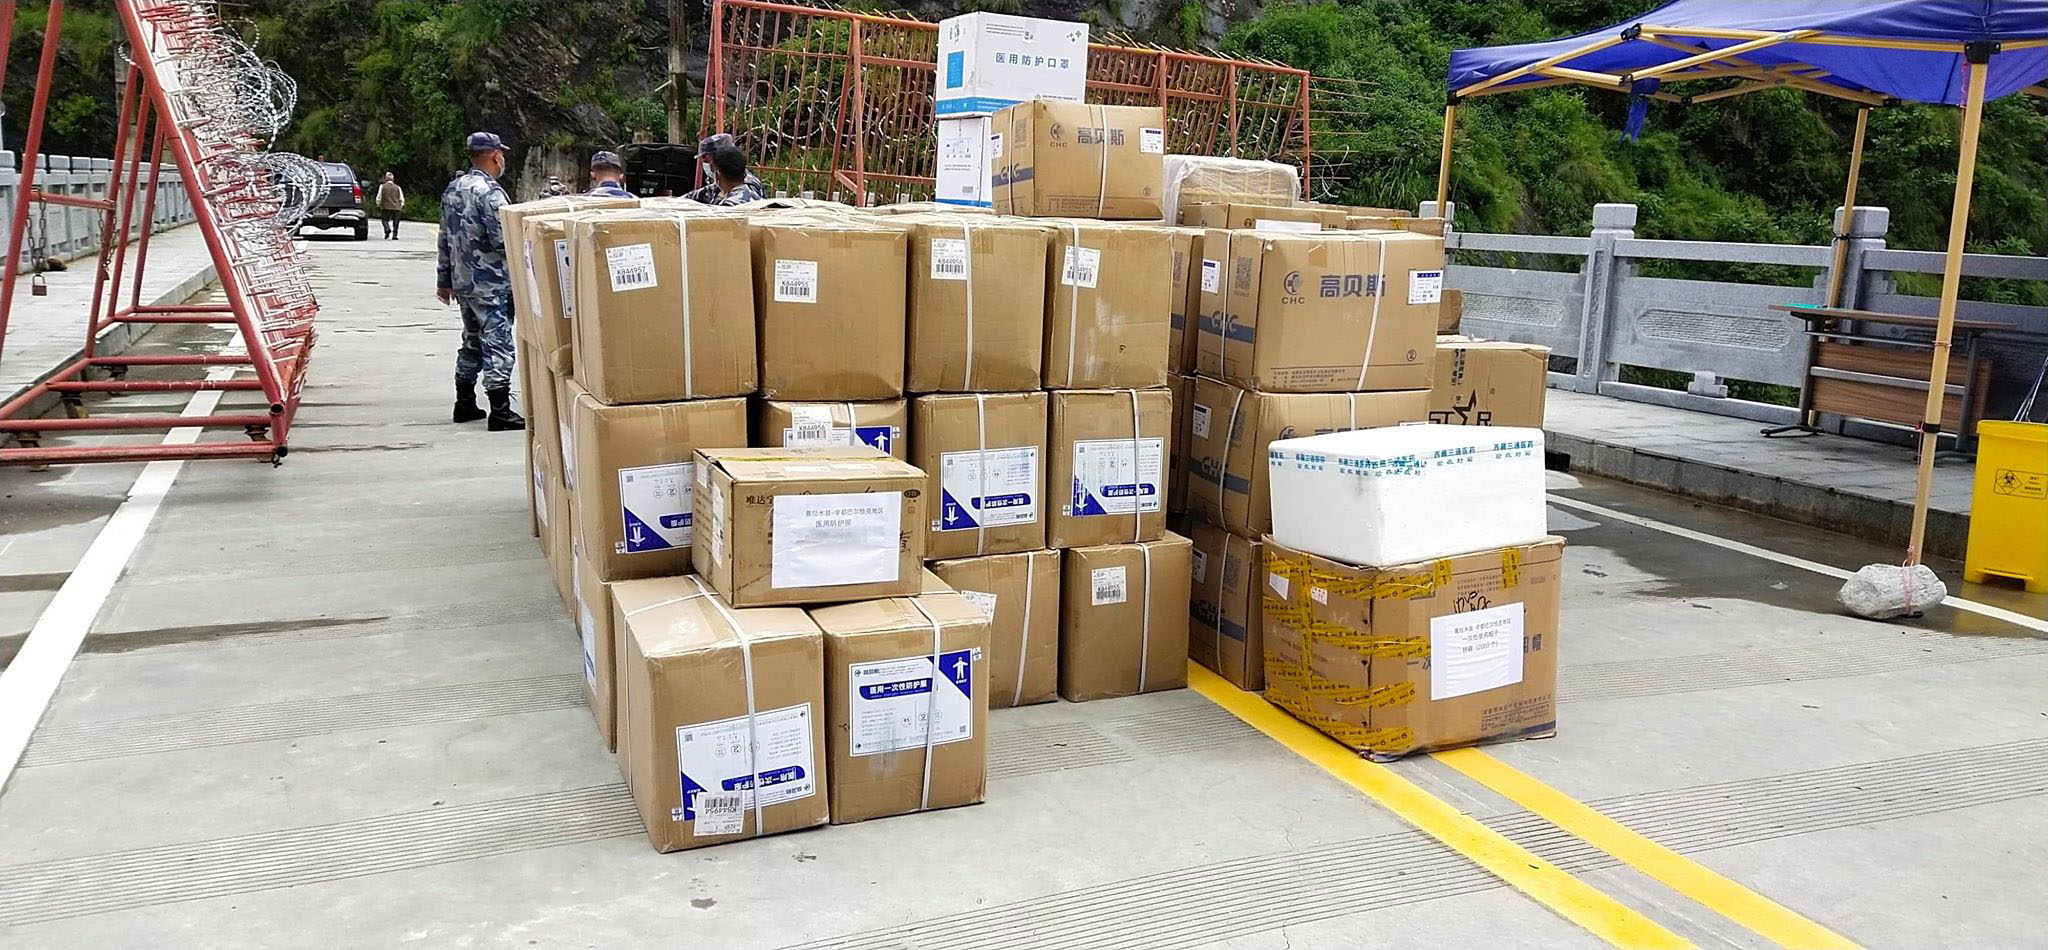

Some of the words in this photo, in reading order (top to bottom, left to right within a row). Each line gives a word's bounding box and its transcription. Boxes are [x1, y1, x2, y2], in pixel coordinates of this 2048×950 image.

[995, 52, 1070, 69] 医用防护口罩
[1077, 127, 1124, 146] 高贝斯
[617, 266, 646, 276] K844957
[1320, 274, 1386, 298] 高贝斯
[1281, 296, 1305, 305] CHC
[869, 679, 928, 695] 医用一次性防护服
